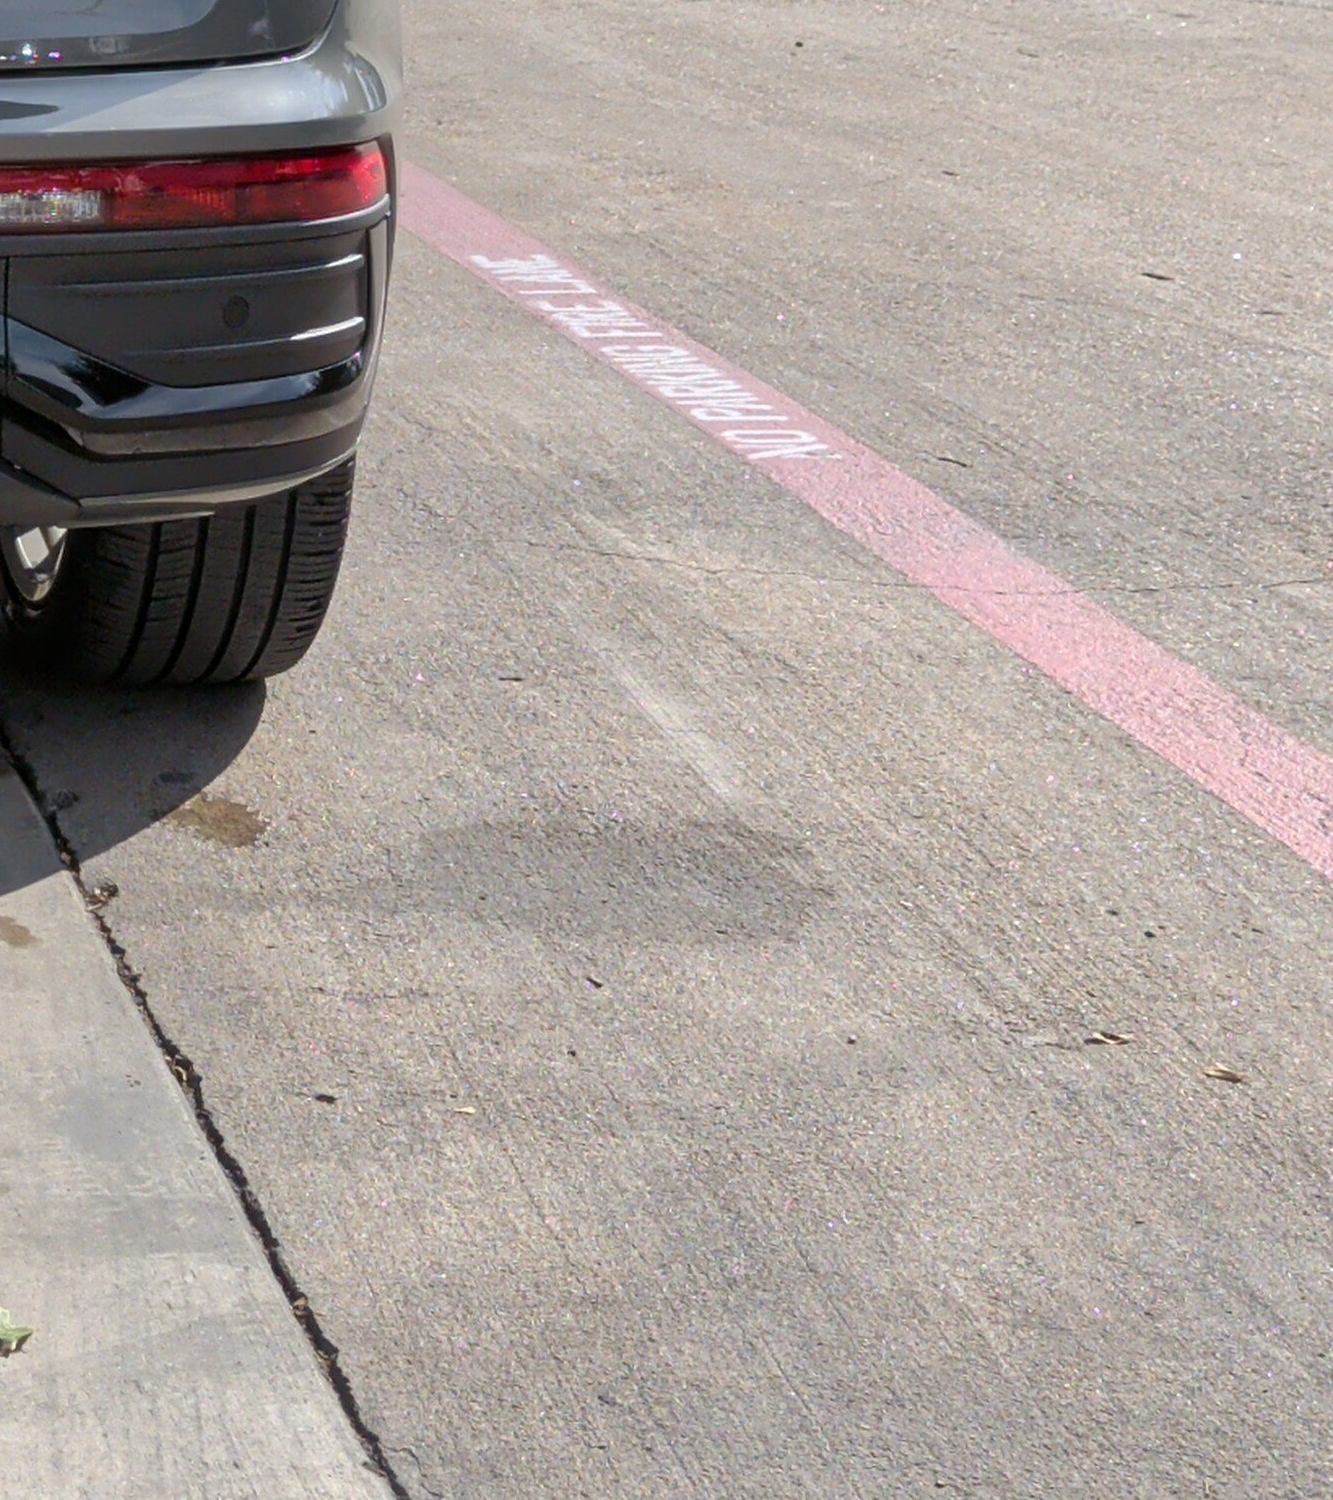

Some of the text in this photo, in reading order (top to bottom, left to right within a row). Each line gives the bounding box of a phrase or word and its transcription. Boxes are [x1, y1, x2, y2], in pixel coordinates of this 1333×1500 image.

[469, 254, 842, 460] NO PARKING FIRE LANE
